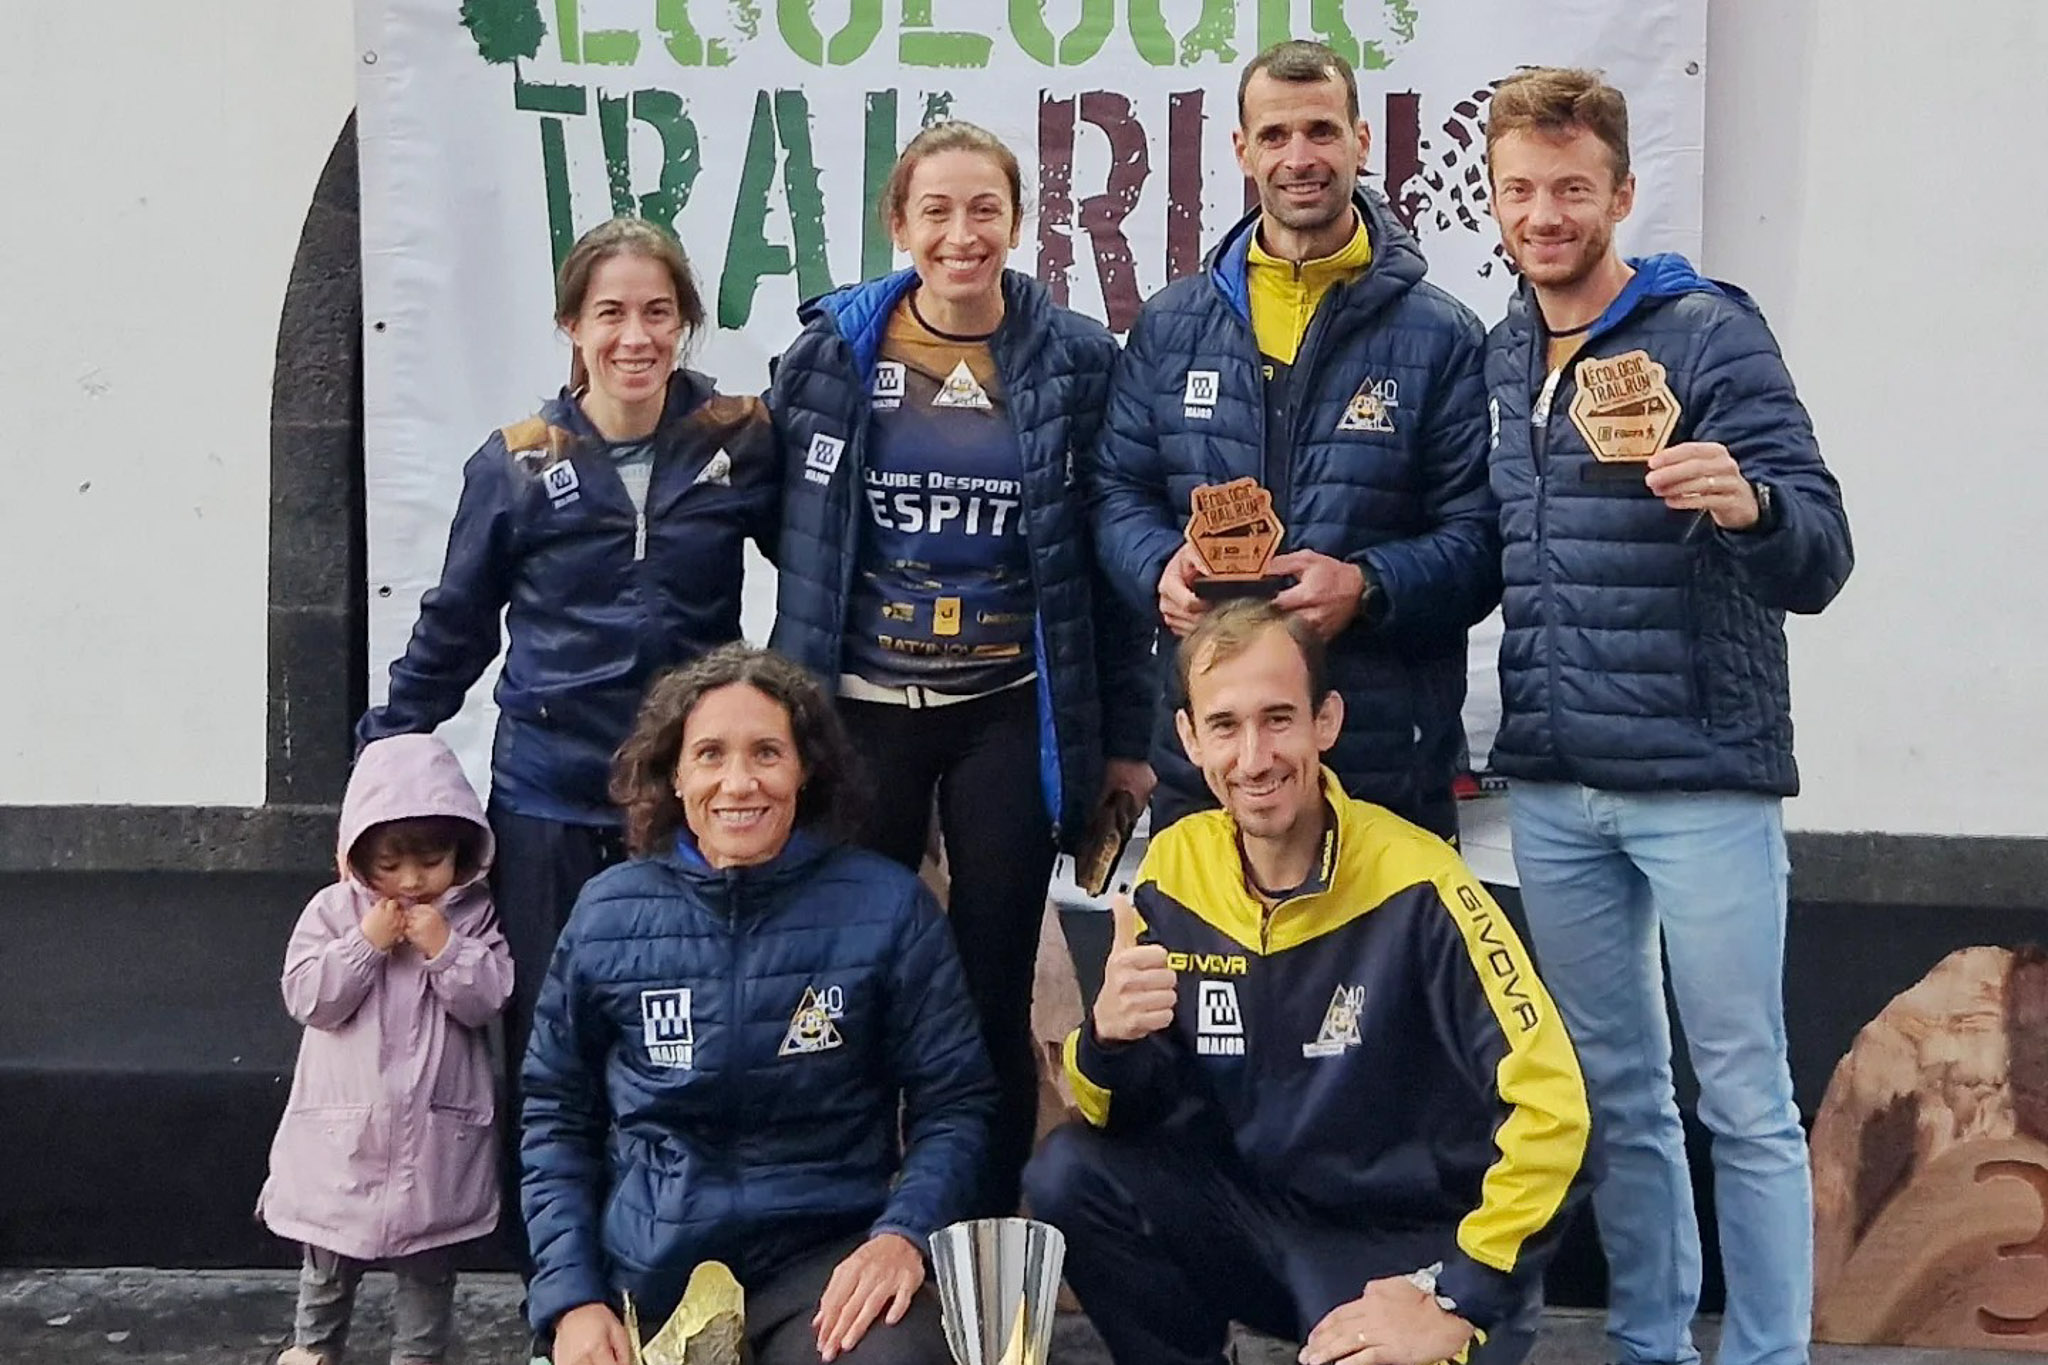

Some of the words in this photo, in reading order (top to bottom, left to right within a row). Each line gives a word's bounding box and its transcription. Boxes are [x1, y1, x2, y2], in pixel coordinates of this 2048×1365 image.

[1371, 379, 1398, 400] 40
[866, 489, 1029, 536] ESPIT
[1167, 952, 1248, 975] GIVOVA
[1457, 885, 1538, 1032] GIVOVA
[814, 985, 844, 1013] 40
